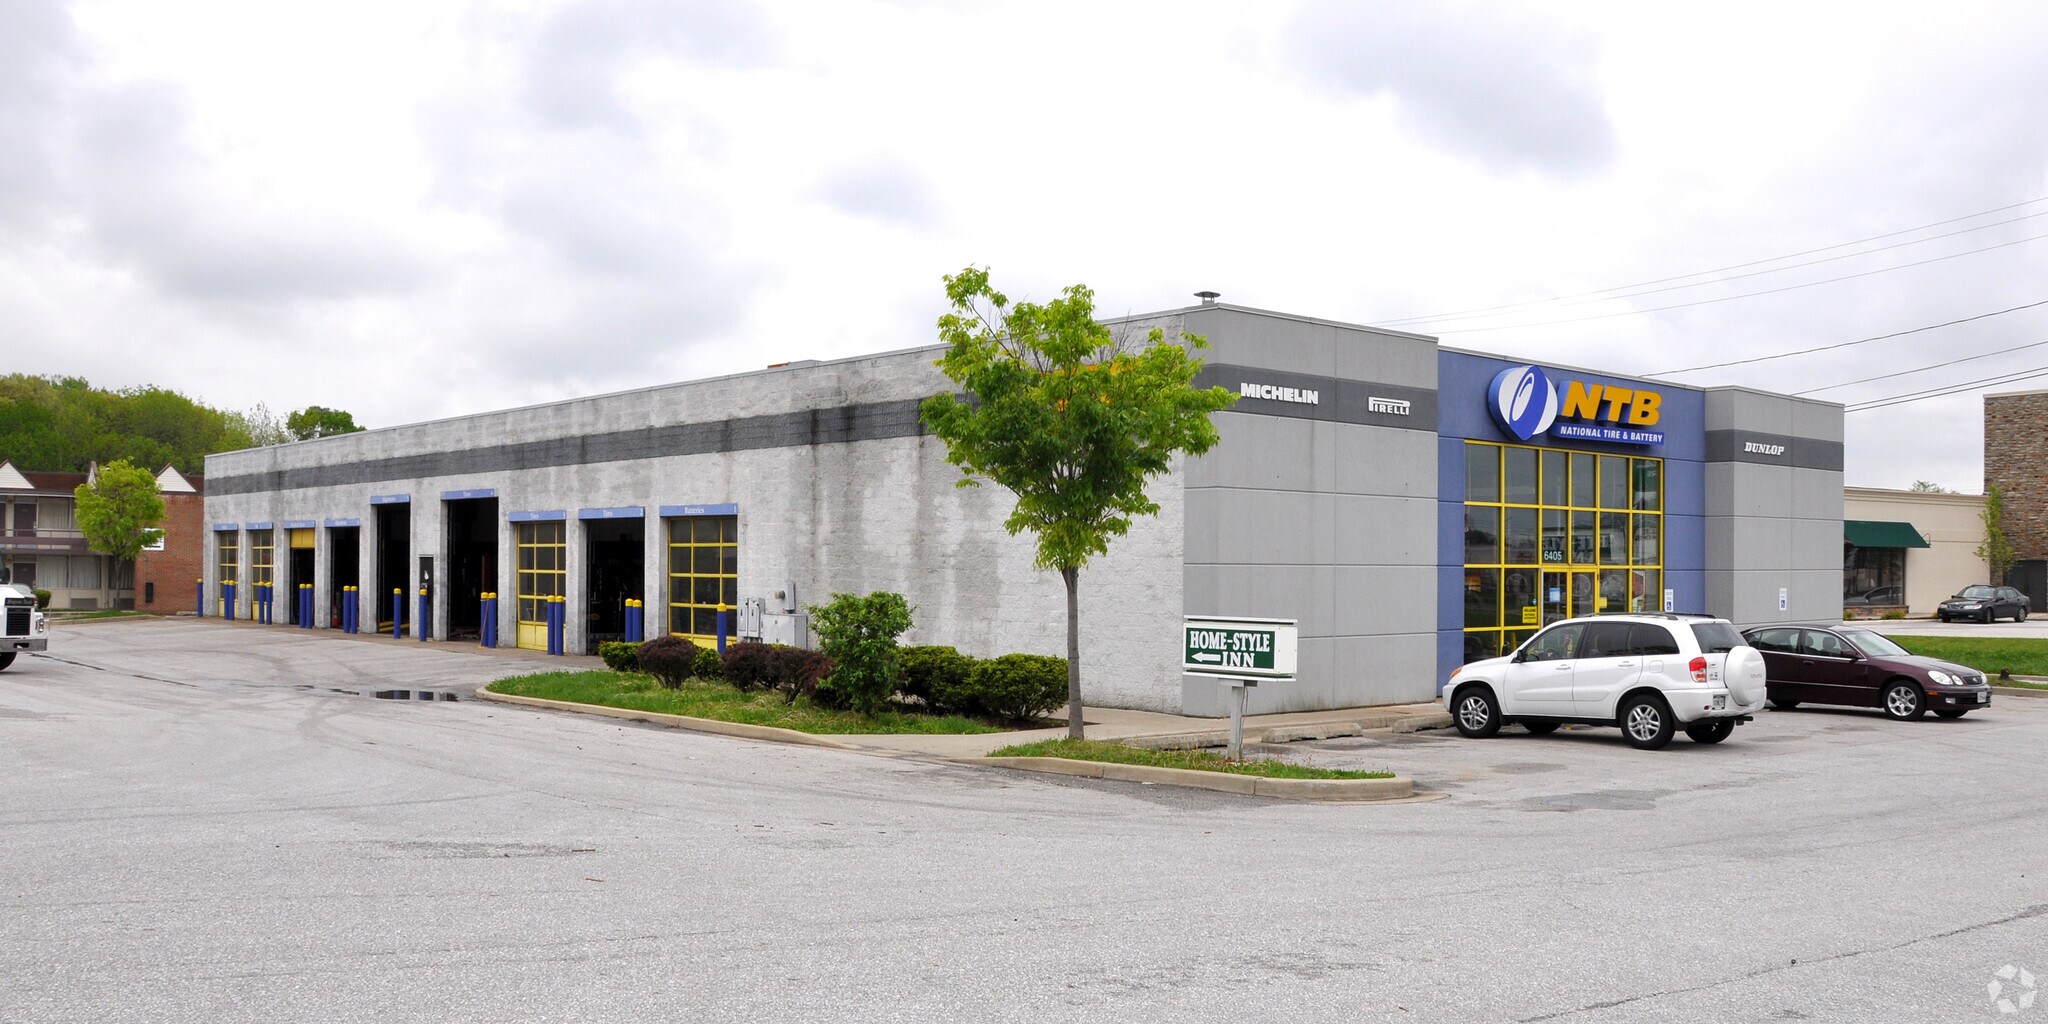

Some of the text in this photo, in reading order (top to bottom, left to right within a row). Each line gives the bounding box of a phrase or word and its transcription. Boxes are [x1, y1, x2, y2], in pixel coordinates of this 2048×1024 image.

[1240, 382, 1319, 405] MICHELIN
[1368, 396, 1411, 416] PIRELLI
[1561, 380, 1663, 426] NTB
[1560, 426, 1664, 443] NATIONAL TIRE & BATTERY
[1744, 441, 1785, 456] DUNLOP
[1544, 551, 1562, 560] 6405
[1190, 631, 1270, 652] HOME-STYLE
[1222, 652, 1255, 667] INN
